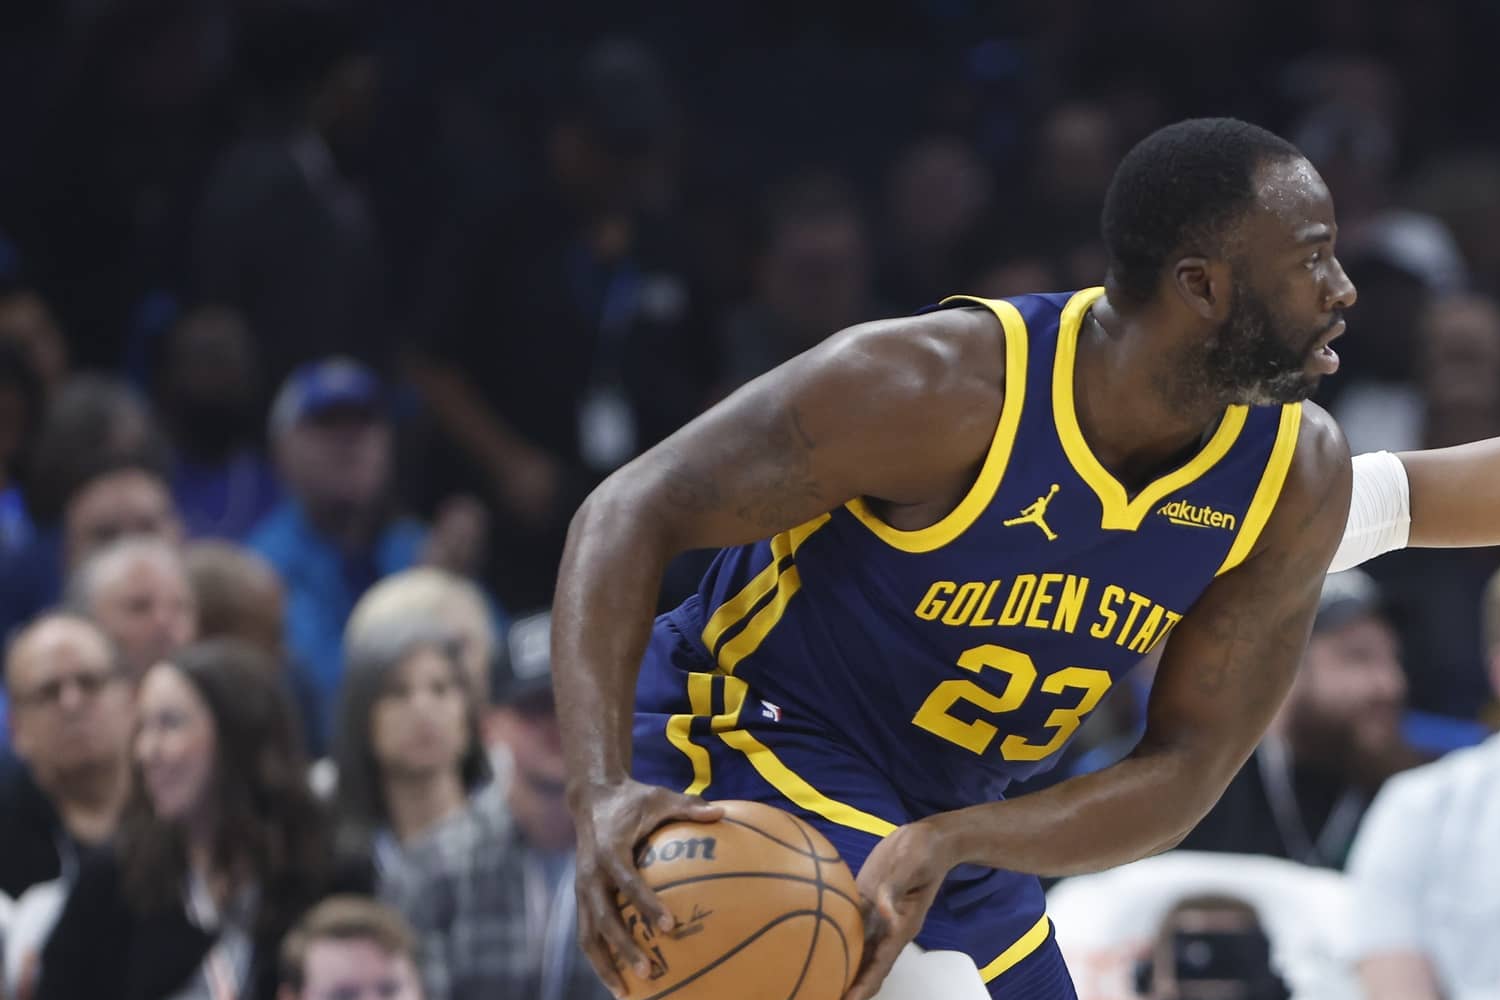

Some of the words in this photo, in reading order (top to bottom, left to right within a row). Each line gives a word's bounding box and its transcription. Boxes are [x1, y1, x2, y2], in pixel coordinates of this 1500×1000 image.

[914, 573, 1089, 633] GOLDEN
[1091, 584, 1183, 654] STAT
[912, 644, 1111, 761] 23
